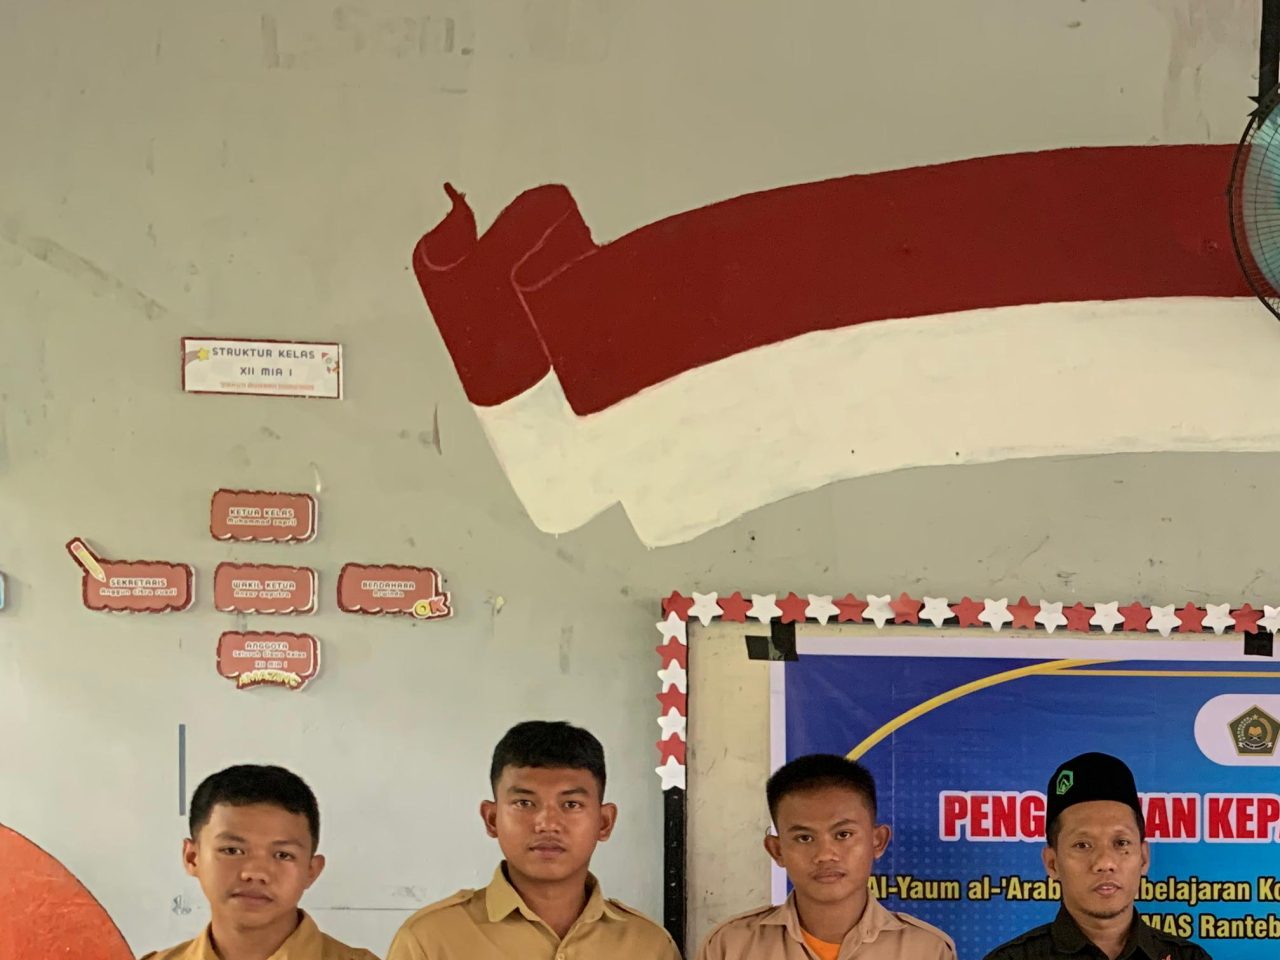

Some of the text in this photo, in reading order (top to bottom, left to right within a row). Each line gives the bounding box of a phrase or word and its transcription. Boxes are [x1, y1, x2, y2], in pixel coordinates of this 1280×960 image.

[212, 347, 315, 359] STRUKTUR KELAS
[240, 367, 255, 376] XII
[261, 367, 283, 376] MIA
[229, 508, 294, 517] KETUA KELAS
[111, 578, 167, 587] SEKRETARIS
[232, 580, 296, 590] WAKIL KETUA
[246, 642, 288, 650] ANGGOTA
[867, 876, 960, 900] Al-Yaum
